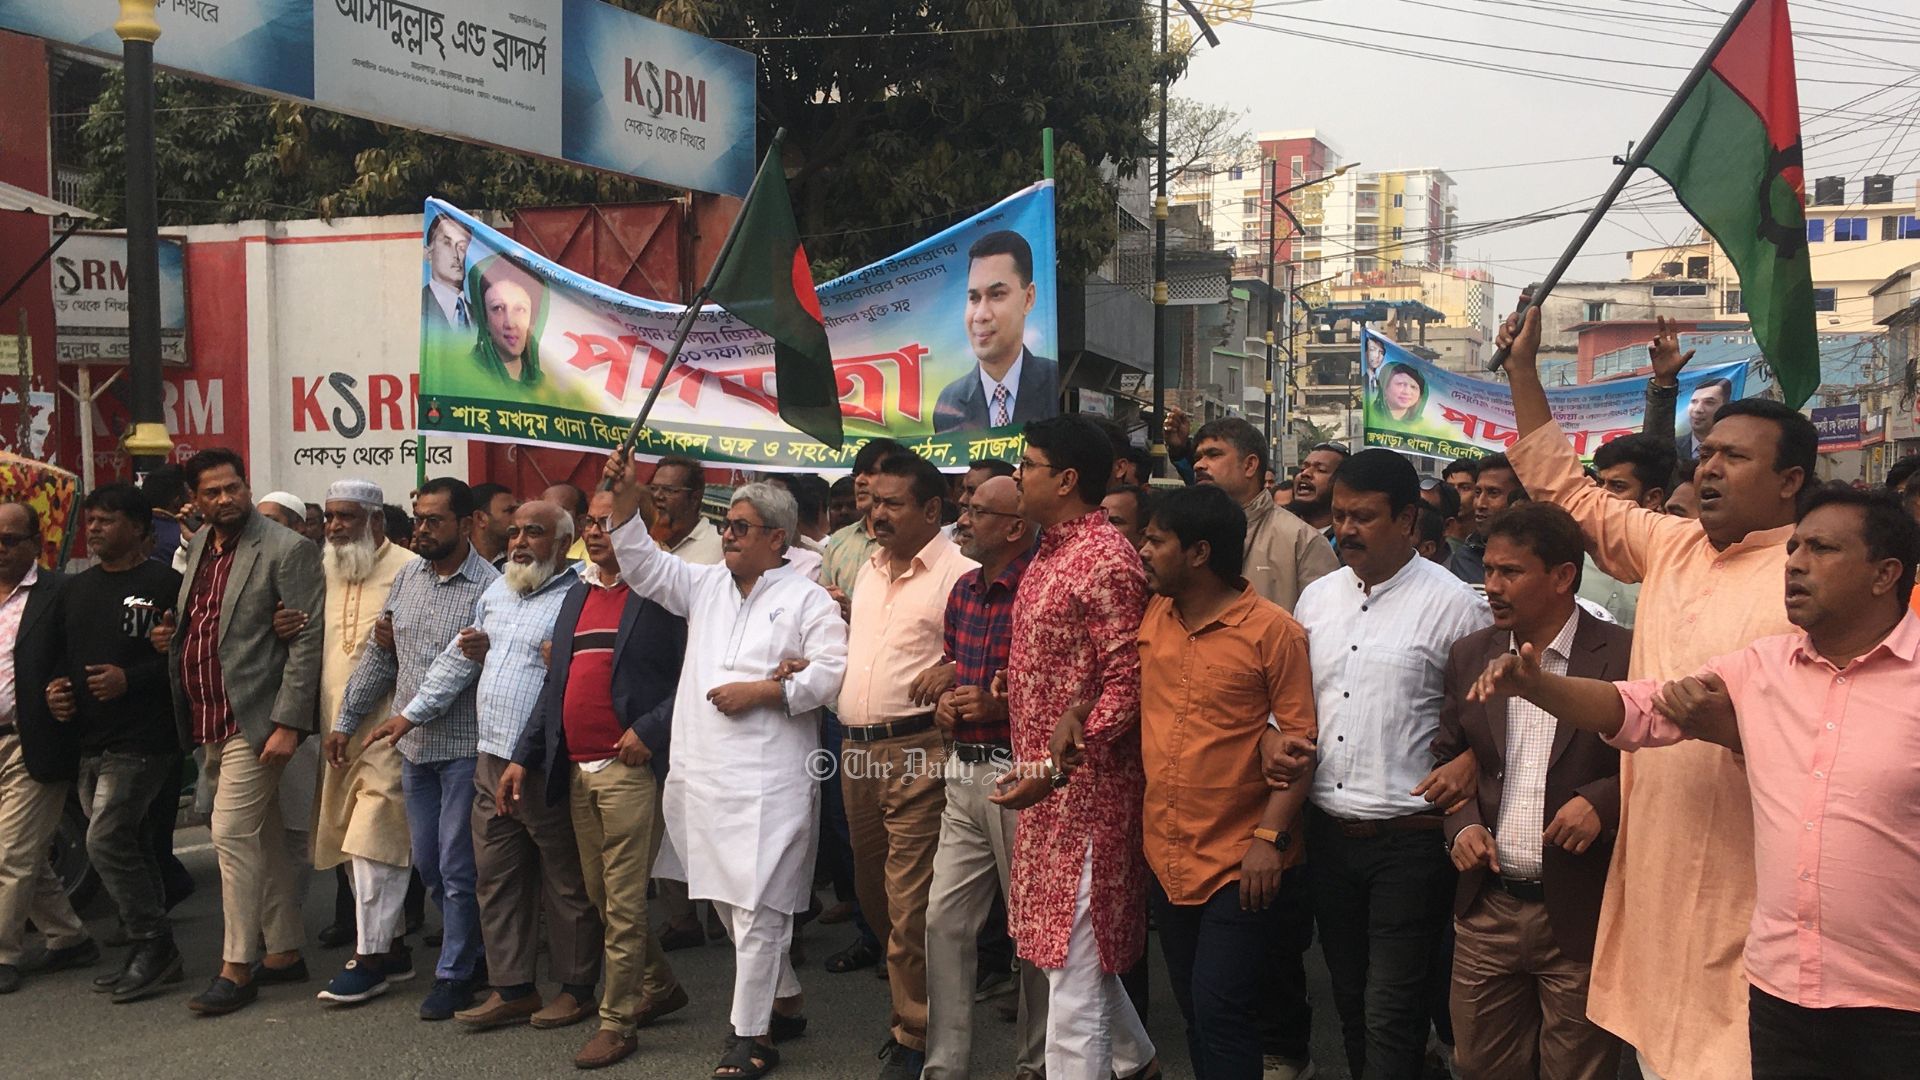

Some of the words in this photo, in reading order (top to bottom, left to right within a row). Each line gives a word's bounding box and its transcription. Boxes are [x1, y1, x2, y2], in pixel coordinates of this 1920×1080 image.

[492, 29, 547, 75] ব্রাদার্স
[624, 56, 706, 123] KSRM
[624, 117, 653, 140] শেকড়
[655, 126, 678, 144] থেকে
[680, 127, 706, 151] শিখরে
[54, 256, 128, 295] SRM
[830, 281, 895, 308] সরকারের
[895, 263, 948, 287] পদত্যাগ
[892, 298, 912, 314] সহ
[678, 350, 702, 363] ১০
[701, 344, 742, 360] দফা
[496, 409, 549, 439] মখদুম
[553, 415, 587, 440] থানা
[719, 434, 757, 457] অঙ্গ
[763, 440, 779, 457] ও
[1407, 438, 1434, 453] থানা
[1437, 440, 1485, 460] বিএনপি
[294, 446, 347, 469] শেকড়
[353, 446, 395, 466] থেকে
[400, 439, 453, 465] শিরে
